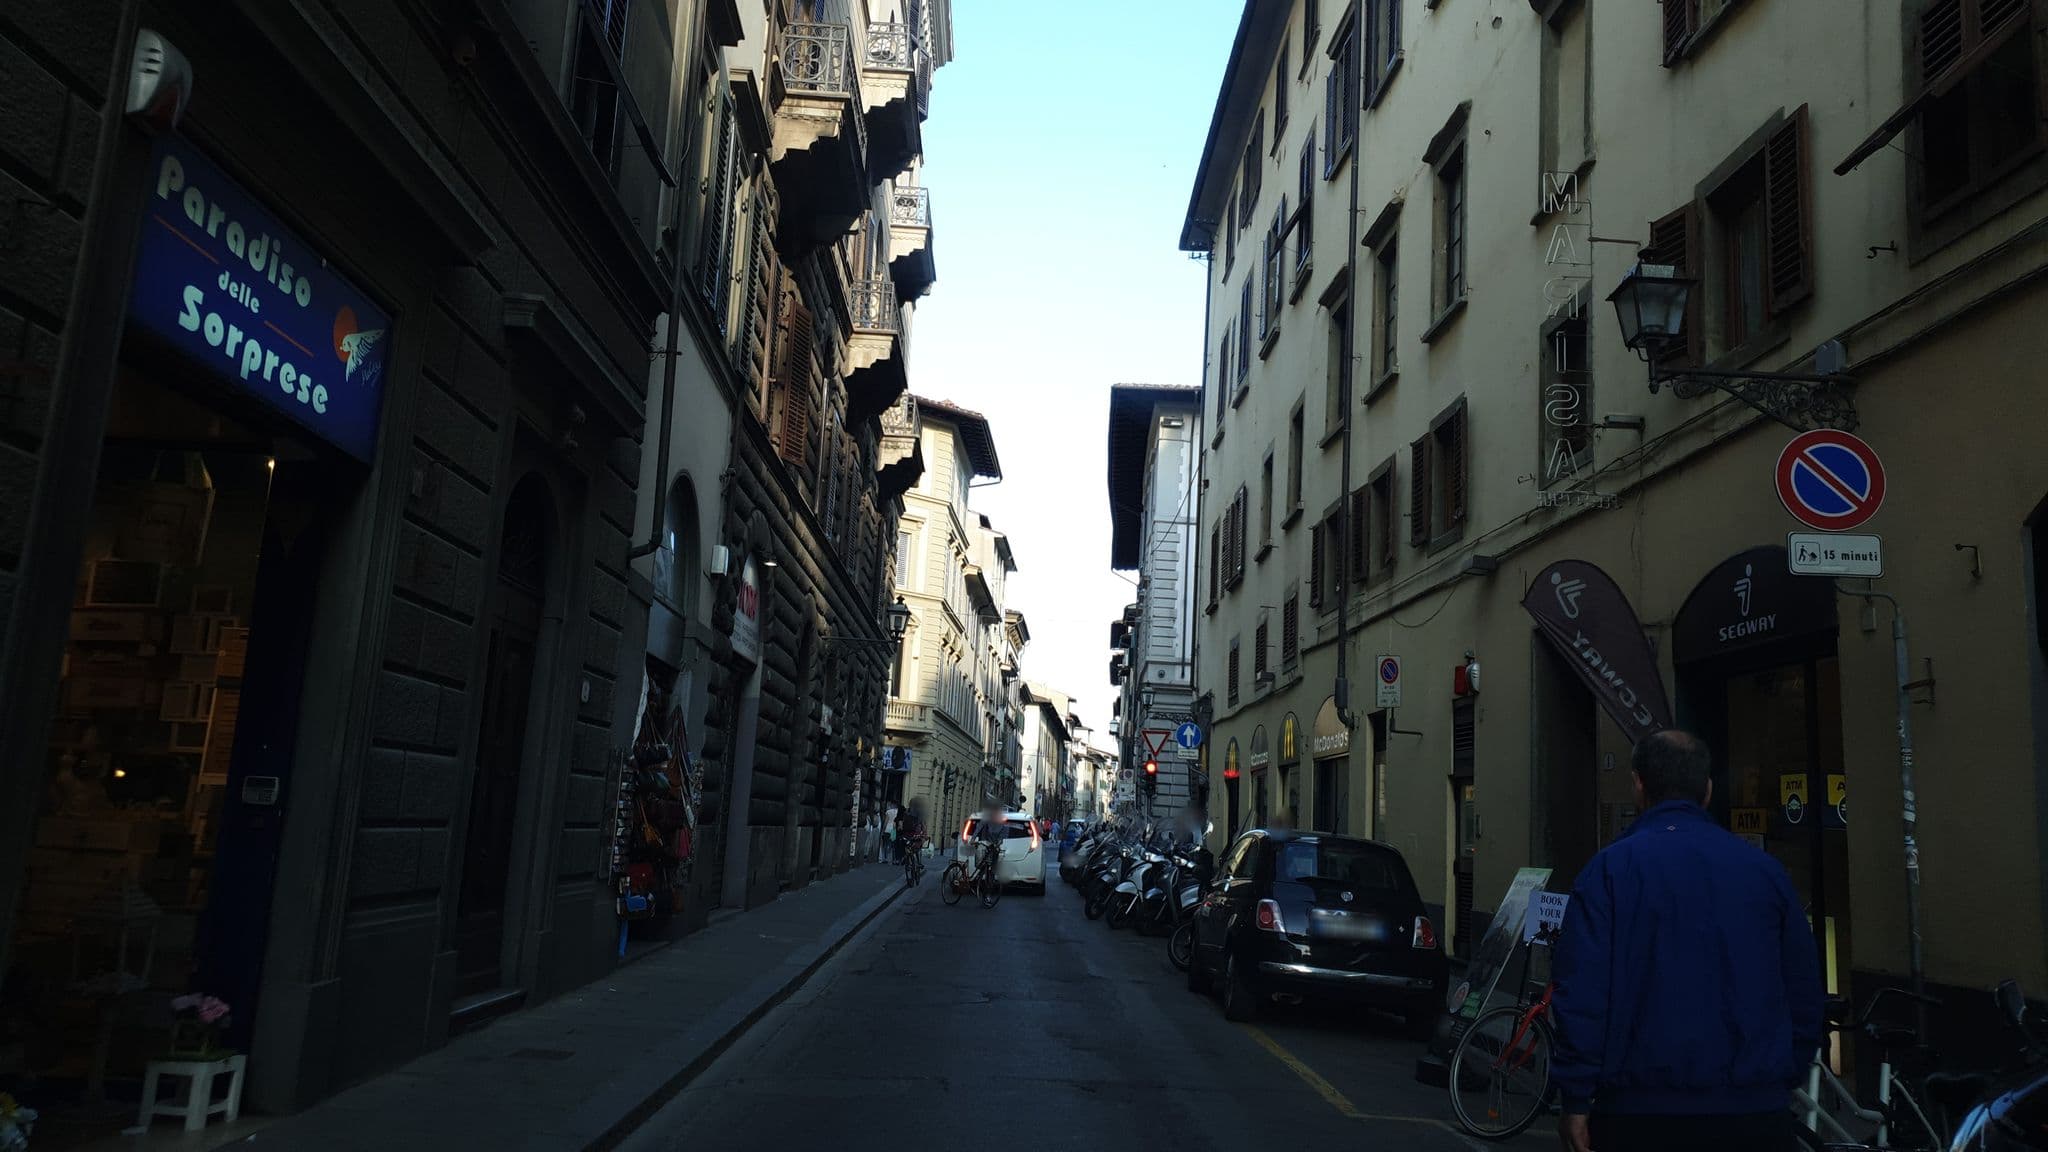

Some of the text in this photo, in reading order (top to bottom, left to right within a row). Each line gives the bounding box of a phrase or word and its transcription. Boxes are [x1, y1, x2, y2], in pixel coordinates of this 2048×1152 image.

[156, 155, 312, 307] Paradiso
[217, 270, 260, 313] delle
[178, 284, 328, 414] Sorprese
[1823, 550, 1878, 561] 15 minuti
[1719, 614, 1777, 642] SEGWAY
[1785, 779, 1802, 791] ATM
[1737, 813, 1761, 829] ATM
[1541, 895, 1563, 906] BOOK
[1540, 907, 1561, 919] YOUR
